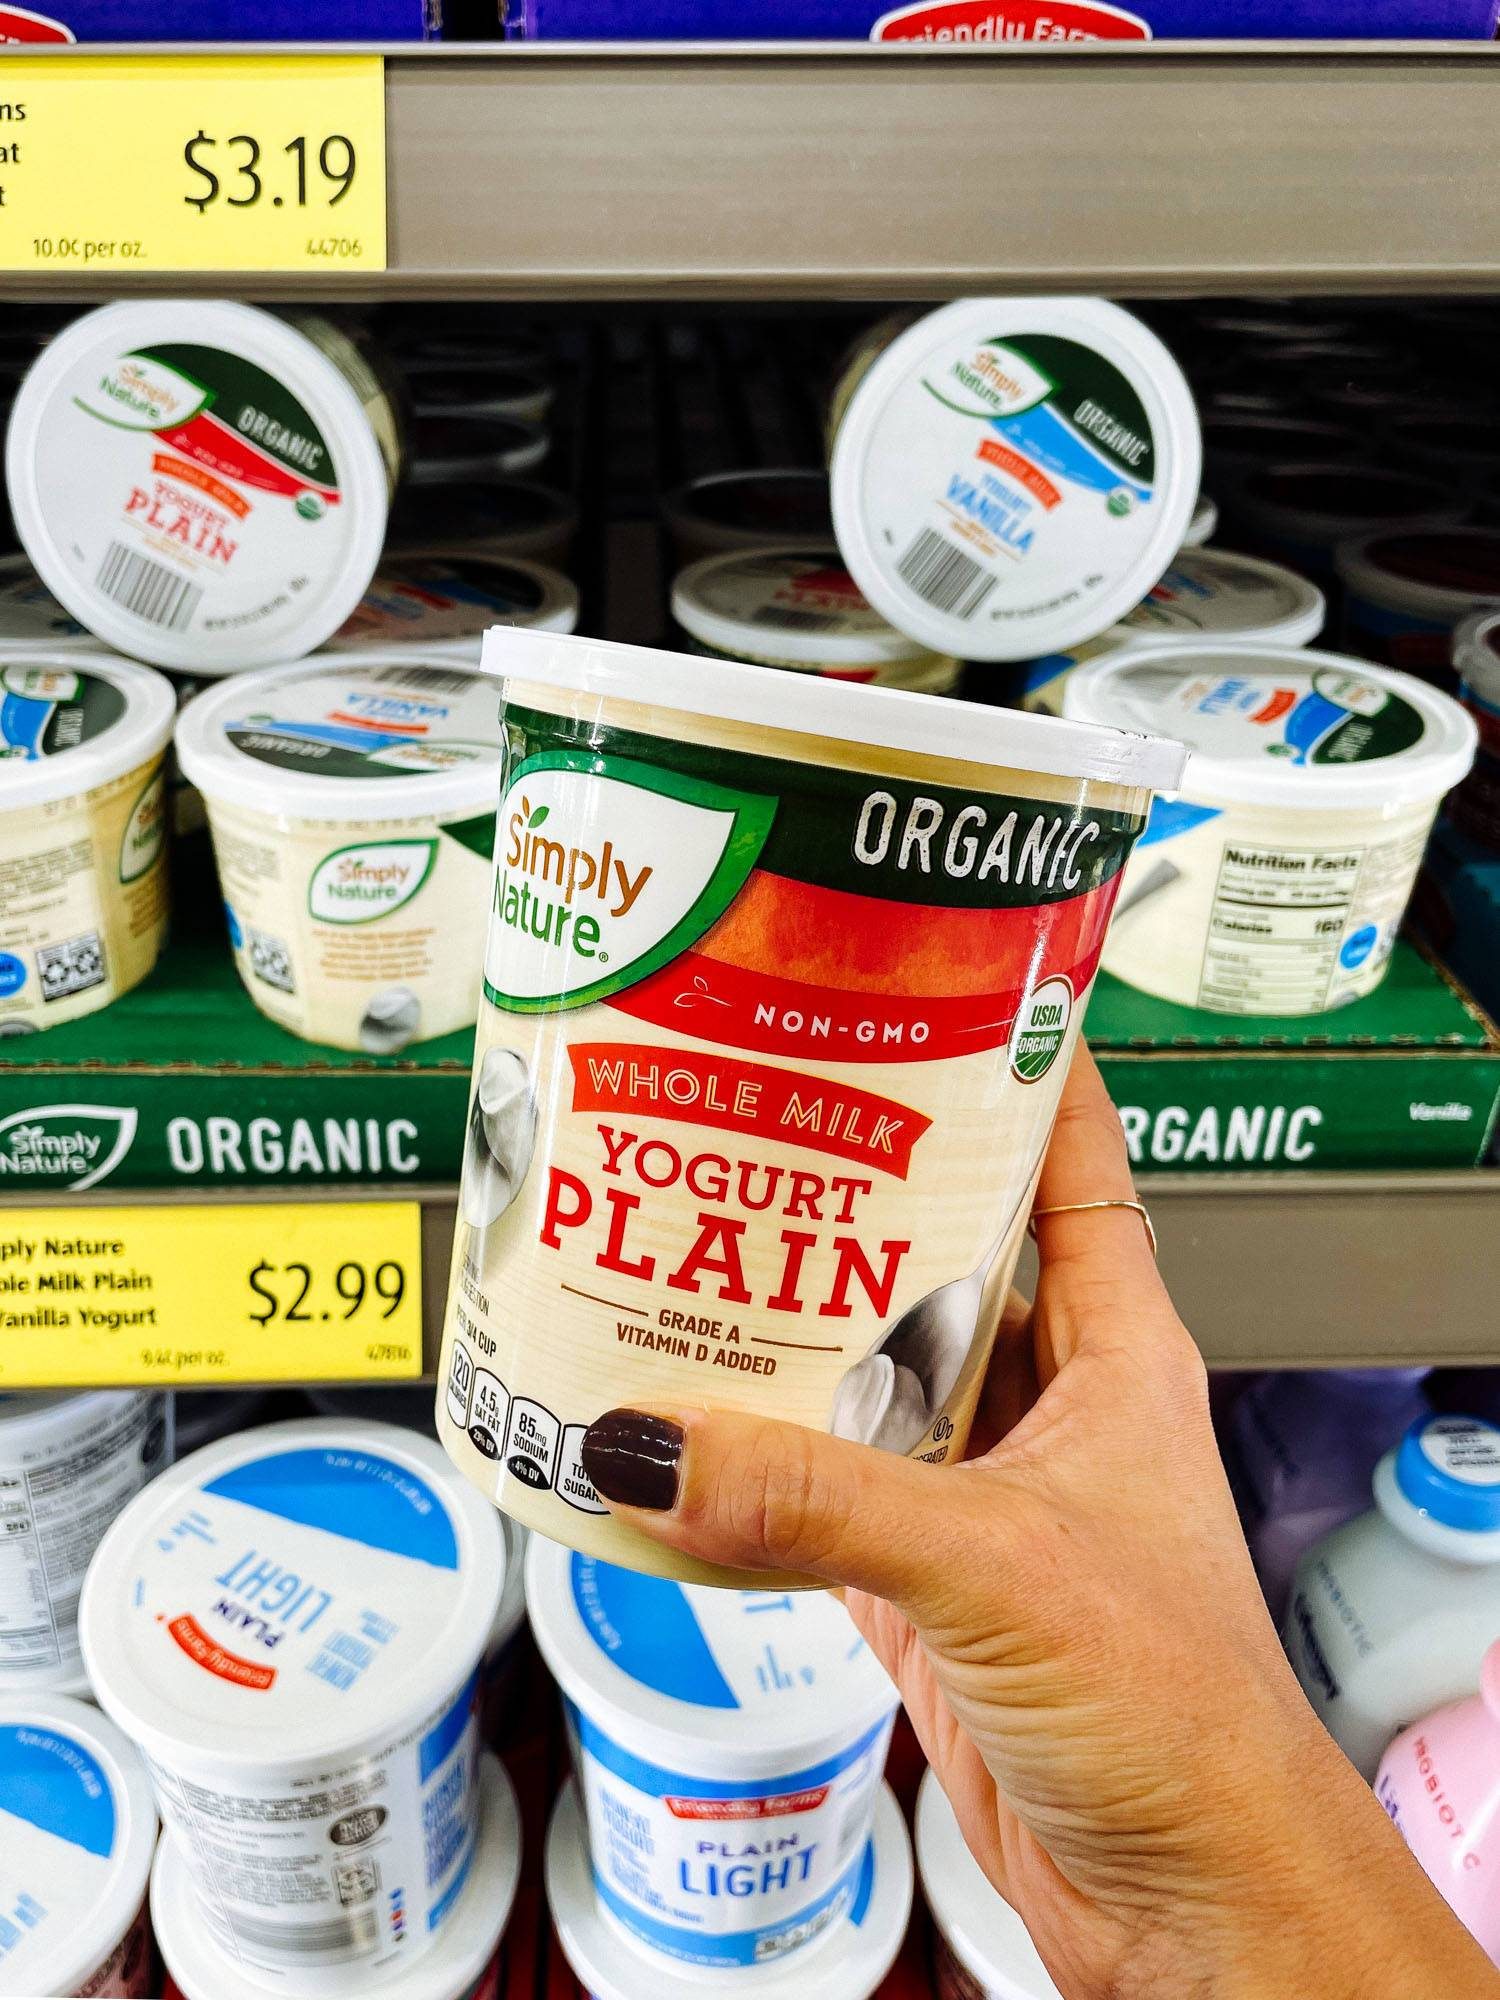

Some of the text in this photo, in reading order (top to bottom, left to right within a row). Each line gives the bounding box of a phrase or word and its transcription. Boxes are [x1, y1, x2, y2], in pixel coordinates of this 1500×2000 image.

[184, 130, 356, 213] $3.19
[84, 241, 118, 263] per
[237, 404, 324, 471] ORGANIC
[1073, 399, 1149, 466] ORGANIC
[124, 486, 239, 566] PLAIN
[506, 796, 653, 917] Simply
[854, 791, 1099, 889] ORGANIC
[1226, 850, 1358, 870] Nutrition Facts
[338, 859, 410, 884] Simply
[328, 884, 397, 901] Nature
[754, 1003, 930, 1044] NON-GMO
[1030, 1005, 1063, 1026] USDA
[1017, 1035, 1060, 1053] ORGANIC
[588, 1058, 904, 1153] WHOLE MILK
[1409, 1101, 1473, 1121] Vanilla
[9, 1126, 101, 1159] Simply
[167, 1116, 420, 1174] ORGANIC
[1117, 1105, 1323, 1162] RGANIC
[598, 1123, 873, 1224] YOGURT
[45, 1238, 124, 1255] Nature
[540, 1166, 911, 1318] PLAIN
[38, 1271, 84, 1290] Milk
[95, 1268, 153, 1289] Plain
[249, 1258, 406, 1328] $2.99
[78, 1307, 156, 1331] Yogurt
[467, 1320, 477, 1343] 3/4
[479, 1331, 497, 1358] CUP
[658, 1309, 740, 1344] GRADE A
[617, 1322, 777, 1376] VITAMIN D ADDED
[453, 1349, 470, 1391] 120
[475, 1403, 501, 1433] SAT FAT
[513, 1433, 549, 1463] SODIUM
[528, 1467, 540, 1481] DV
[215, 1549, 334, 1634] LIGHT
[212, 1599, 284, 1648] PLAIN
[697, 1832, 799, 1857] PLAIN
[680, 1843, 818, 1896] LIGHT
